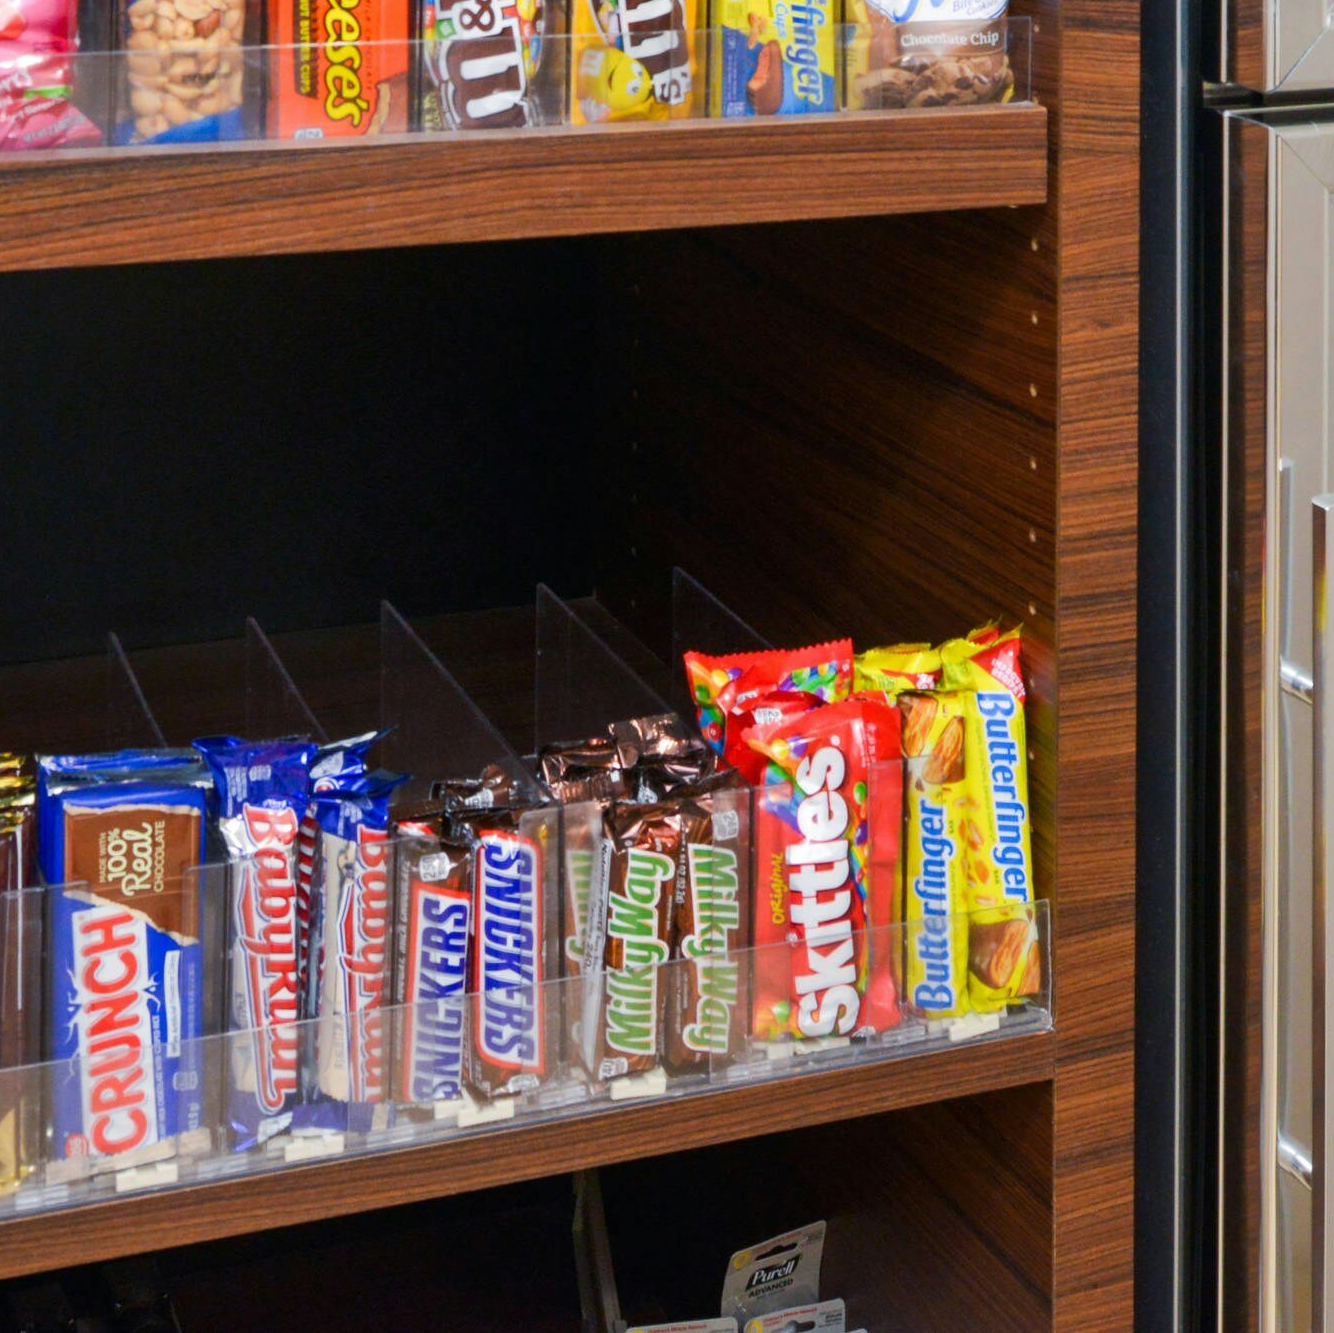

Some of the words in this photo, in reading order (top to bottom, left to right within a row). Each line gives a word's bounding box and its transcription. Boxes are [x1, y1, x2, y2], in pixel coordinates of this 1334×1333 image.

[901, 31, 968, 48] Chocolate
[970, 29, 1000, 48] Chip
[976, 689, 1029, 905] Butterfinger
[106, 827, 127, 880] 100%
[120, 820, 153, 897] Real
[152, 819, 166, 894] CHOCOLATE
[912, 797, 956, 1011] Butterfinger
[483, 843, 536, 1063] SNICKERS
[78, 911, 149, 1154] CRUNCH
[412, 895, 470, 1103] SNICKERS
[748, 1277, 795, 1299] ADVANCED
[752, 1260, 796, 1287] Purell
